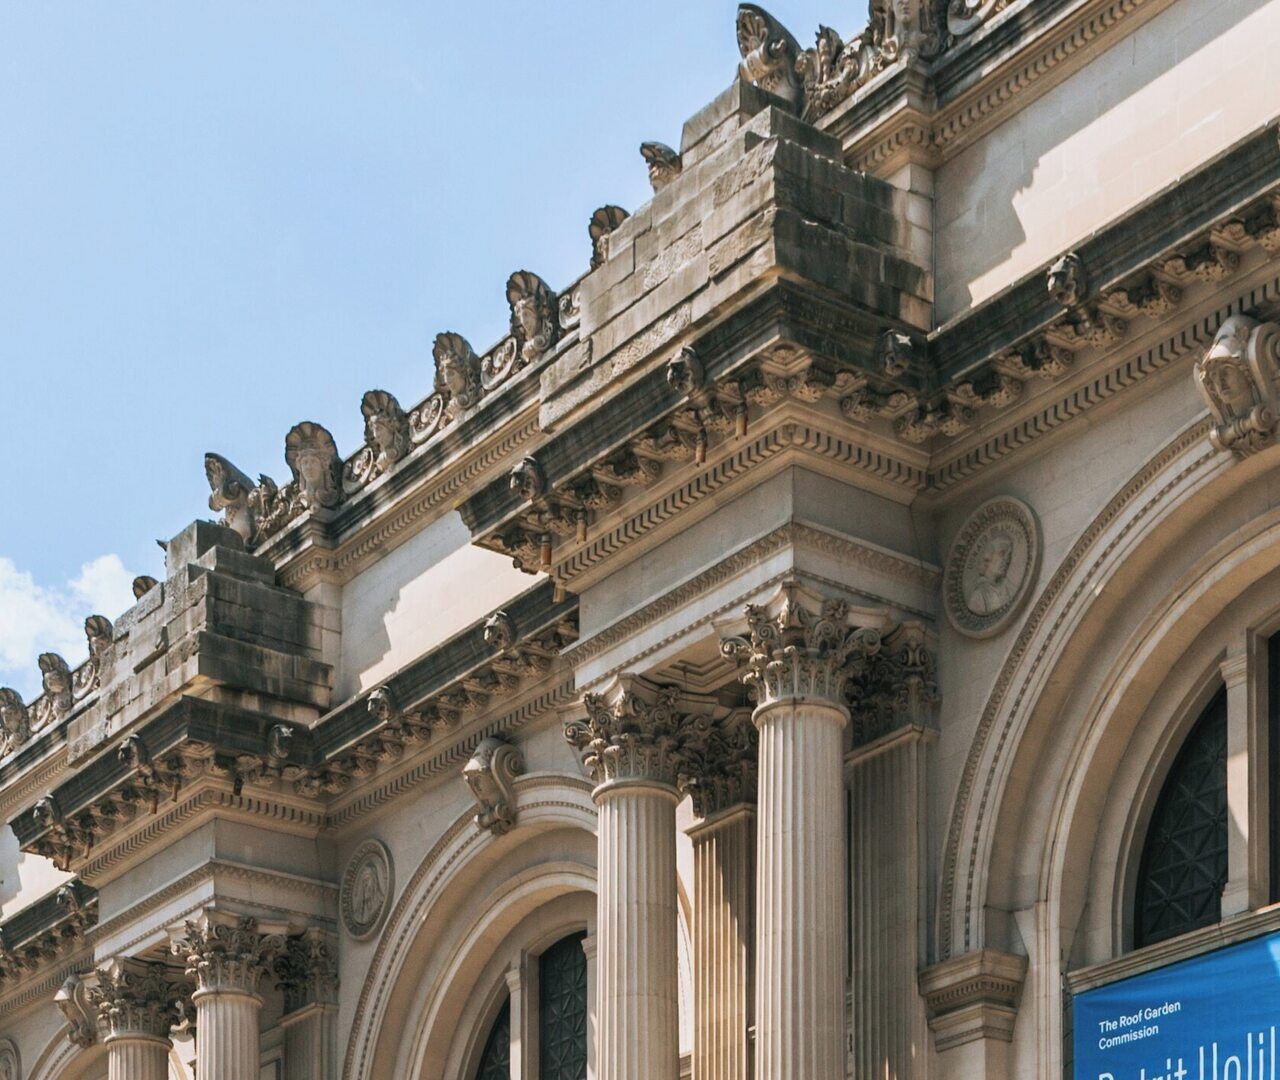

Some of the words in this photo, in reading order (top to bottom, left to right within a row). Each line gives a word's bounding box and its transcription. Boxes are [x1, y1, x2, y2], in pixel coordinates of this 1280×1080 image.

[1099, 1020, 1118, 1033] The
[1119, 1010, 1143, 1028] Roof
[1144, 1001, 1181, 1020] Garden
[1098, 1025, 1159, 1050] Commission
